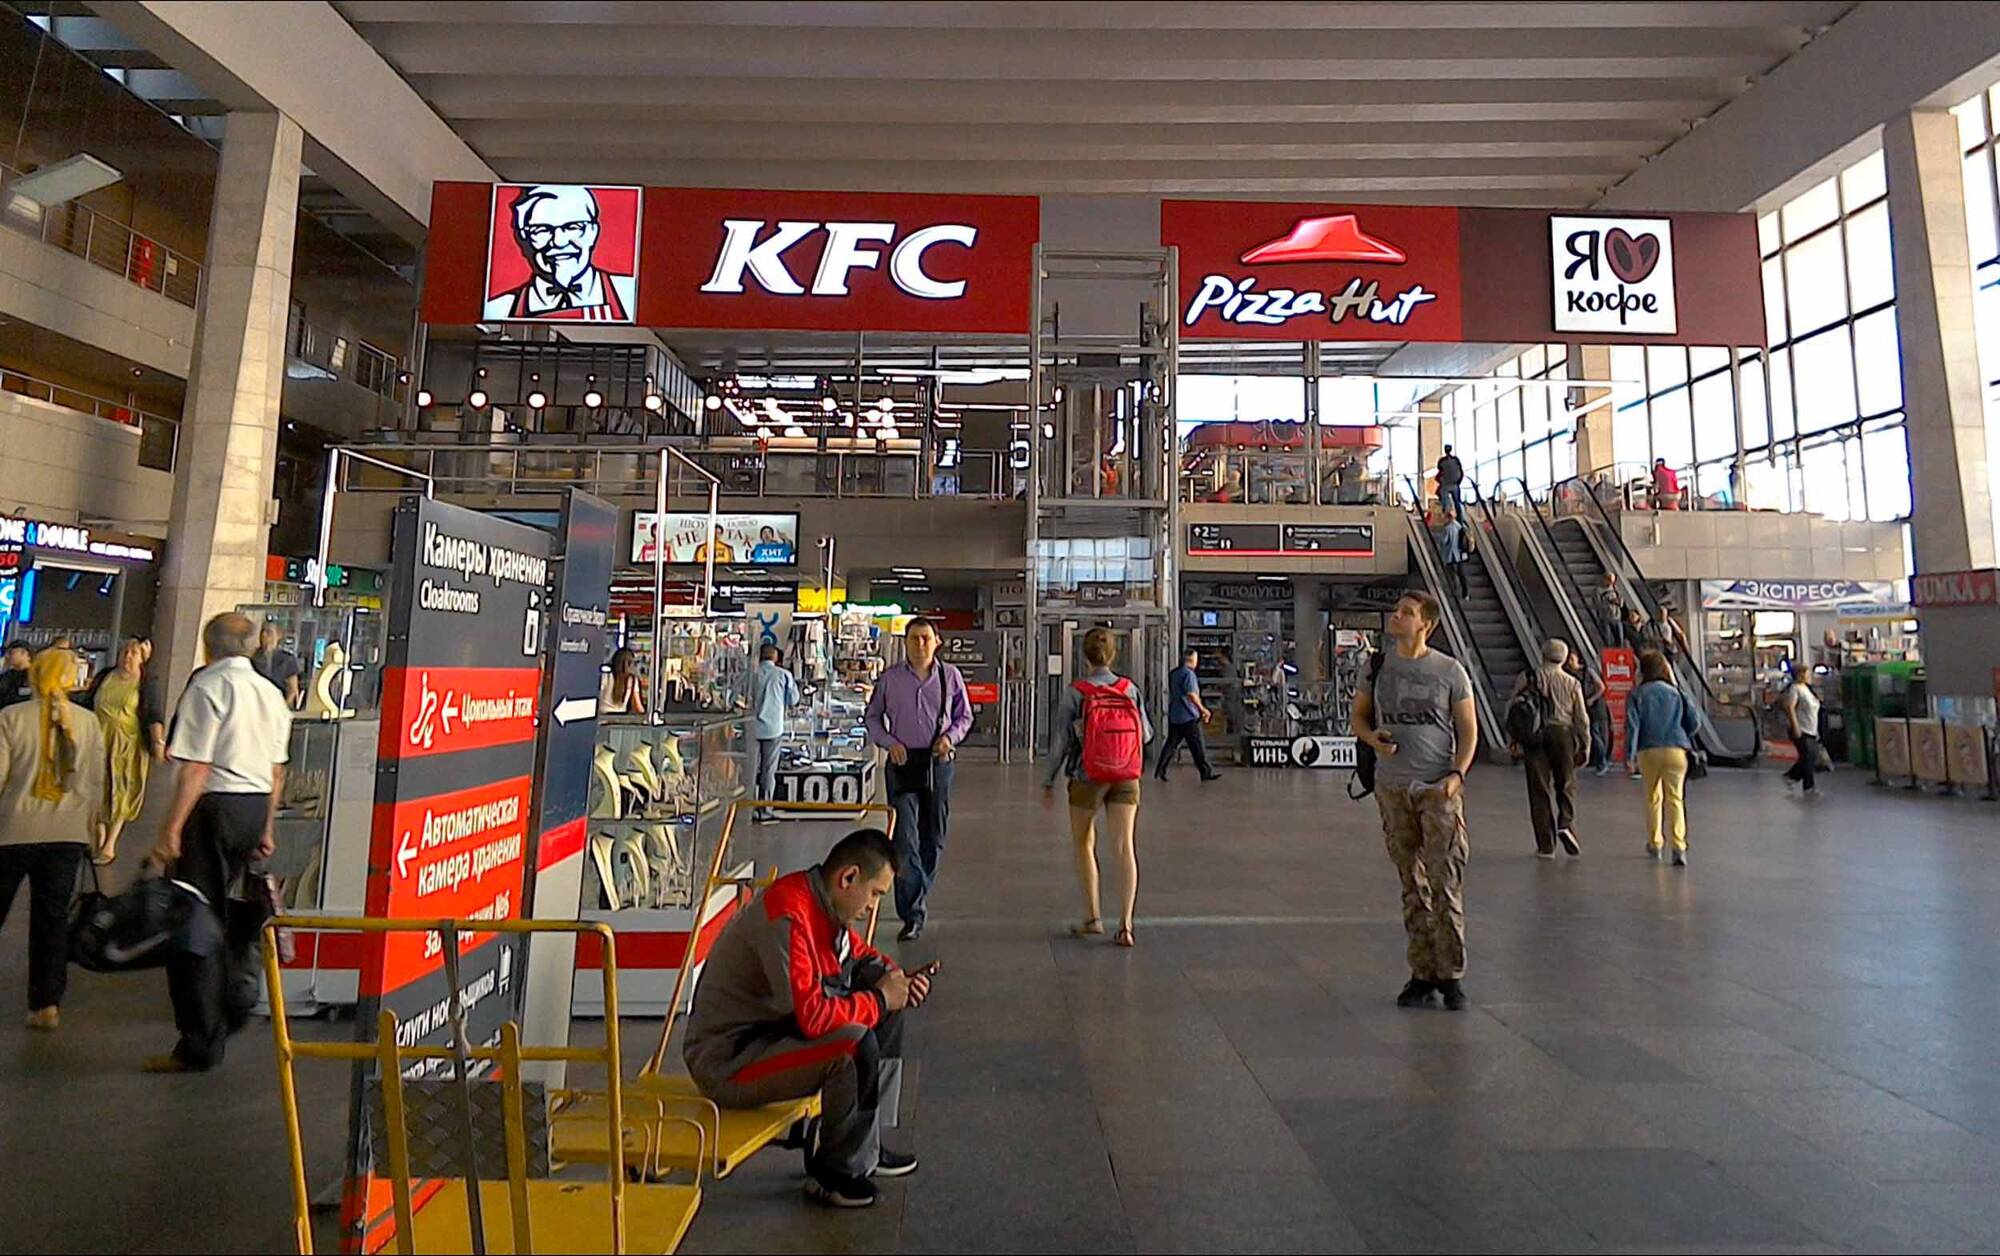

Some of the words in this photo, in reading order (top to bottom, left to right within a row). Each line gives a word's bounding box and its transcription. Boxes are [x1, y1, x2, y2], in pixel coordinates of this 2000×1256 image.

[700, 219, 977, 298] KFC
[1564, 229, 1600, 281] Я
[1186, 274, 1326, 325] Pizza
[1331, 278, 1436, 324] Hut
[1566, 283, 1659, 326] кофе
[676, 530, 699, 547] НЕ
[1201, 526, 1210, 538] 2
[423, 521, 488, 582] Камеры
[488, 545, 547, 588] хранения
[761, 548, 783, 557] ХИТ
[420, 578, 479, 613] Cloakrooms
[1219, 584, 1294, 600] ПРОДУКТЫ
[951, 638, 962, 652] 2
[461, 690, 514, 729] Цокольный
[514, 697, 534, 719] этаж
[1253, 747, 1289, 763] ИНЬ
[1330, 748, 1354, 763] ЯН
[783, 774, 859, 804] 100
[420, 796, 519, 850] Автоматическая
[417, 851, 470, 897] камера
[471, 832, 521, 884] хранения
[395, 1009, 431, 1048] слуги
